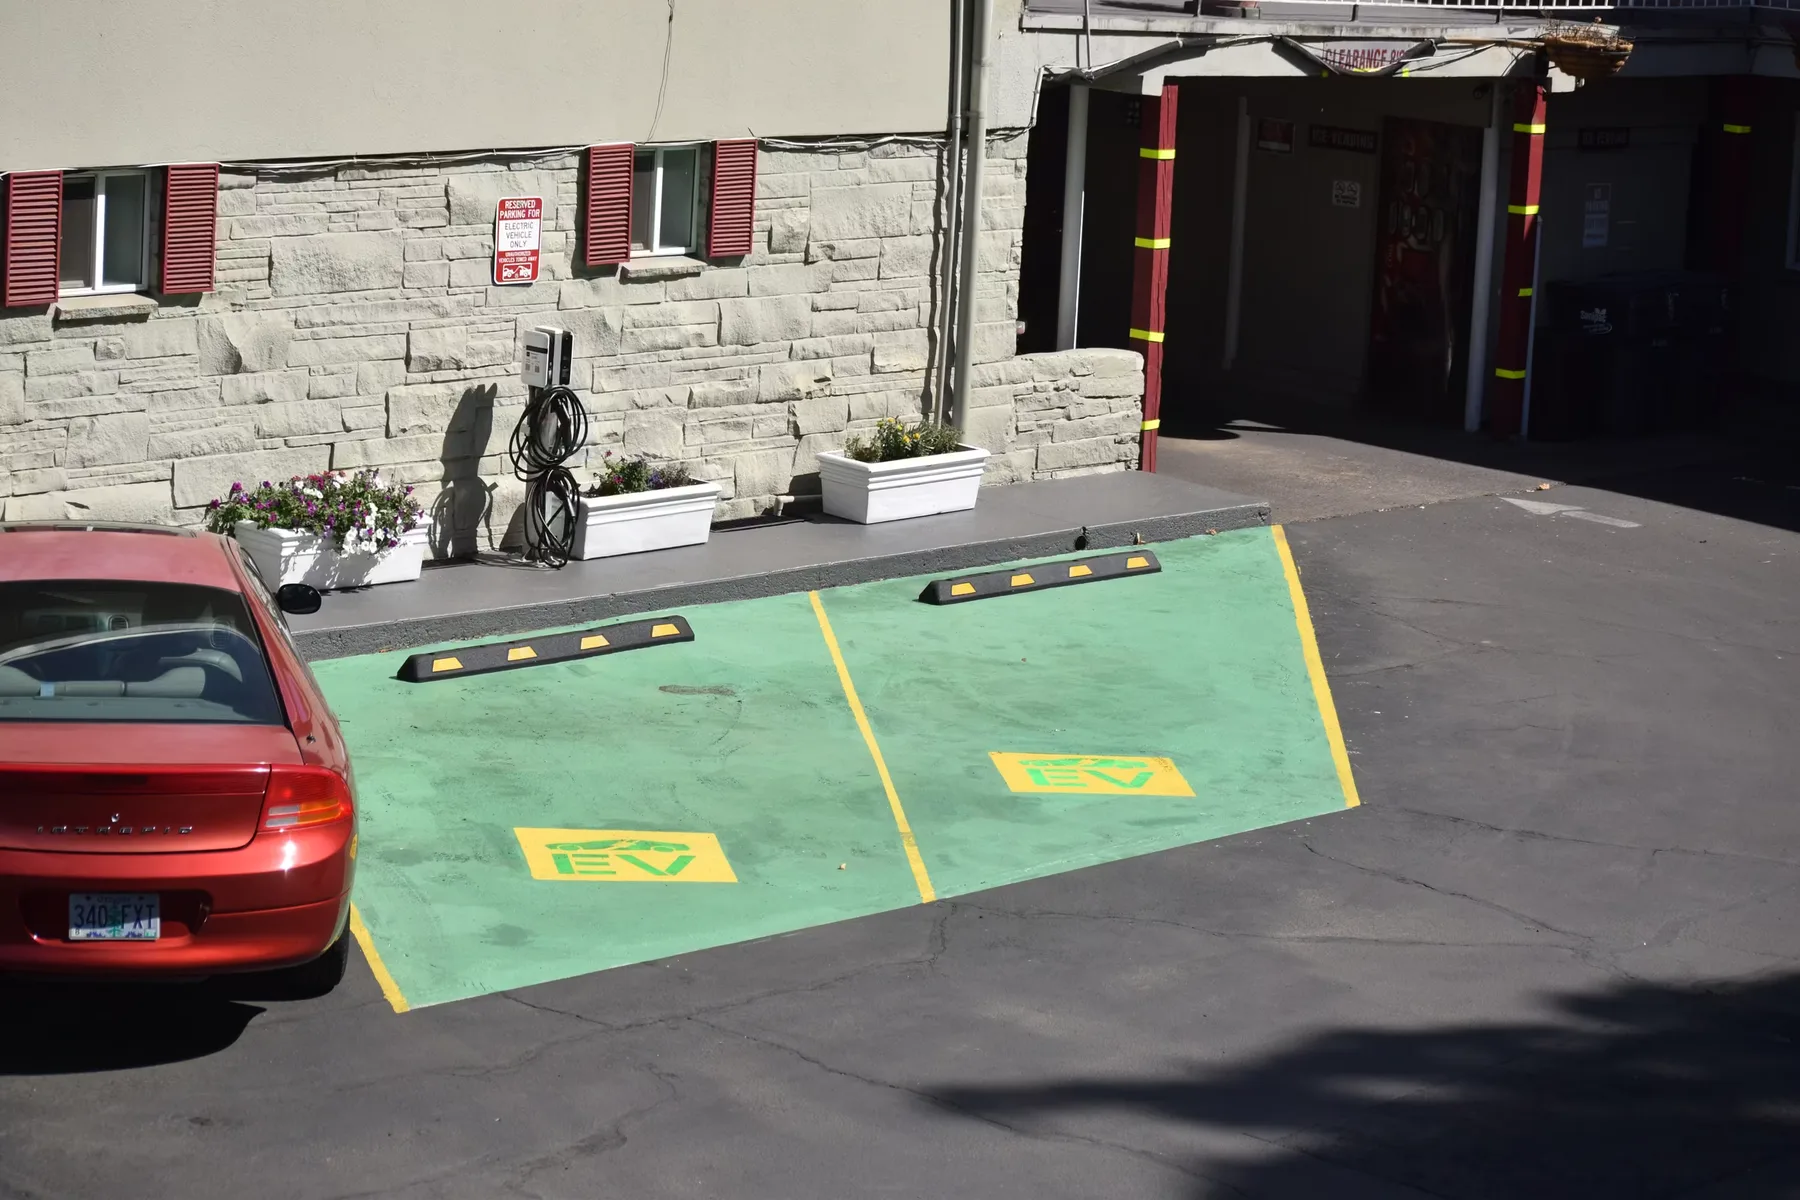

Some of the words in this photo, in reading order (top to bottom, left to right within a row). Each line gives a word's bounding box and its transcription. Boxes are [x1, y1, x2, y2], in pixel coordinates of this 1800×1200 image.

[1325, 48, 1388, 70] CLEARANCE
[505, 200, 536, 209] RESERVED
[499, 210, 526, 218] PARKING
[528, 209, 540, 218] FOR
[504, 222, 534, 230] ELECTRIC
[505, 231, 532, 239] VEHICLE
[509, 240, 527, 248] ONLY
[1026, 768, 1154, 788] EV
[551, 853, 696, 876] EV
[74, 904, 108, 928] 340
[121, 904, 155, 929] FXT
